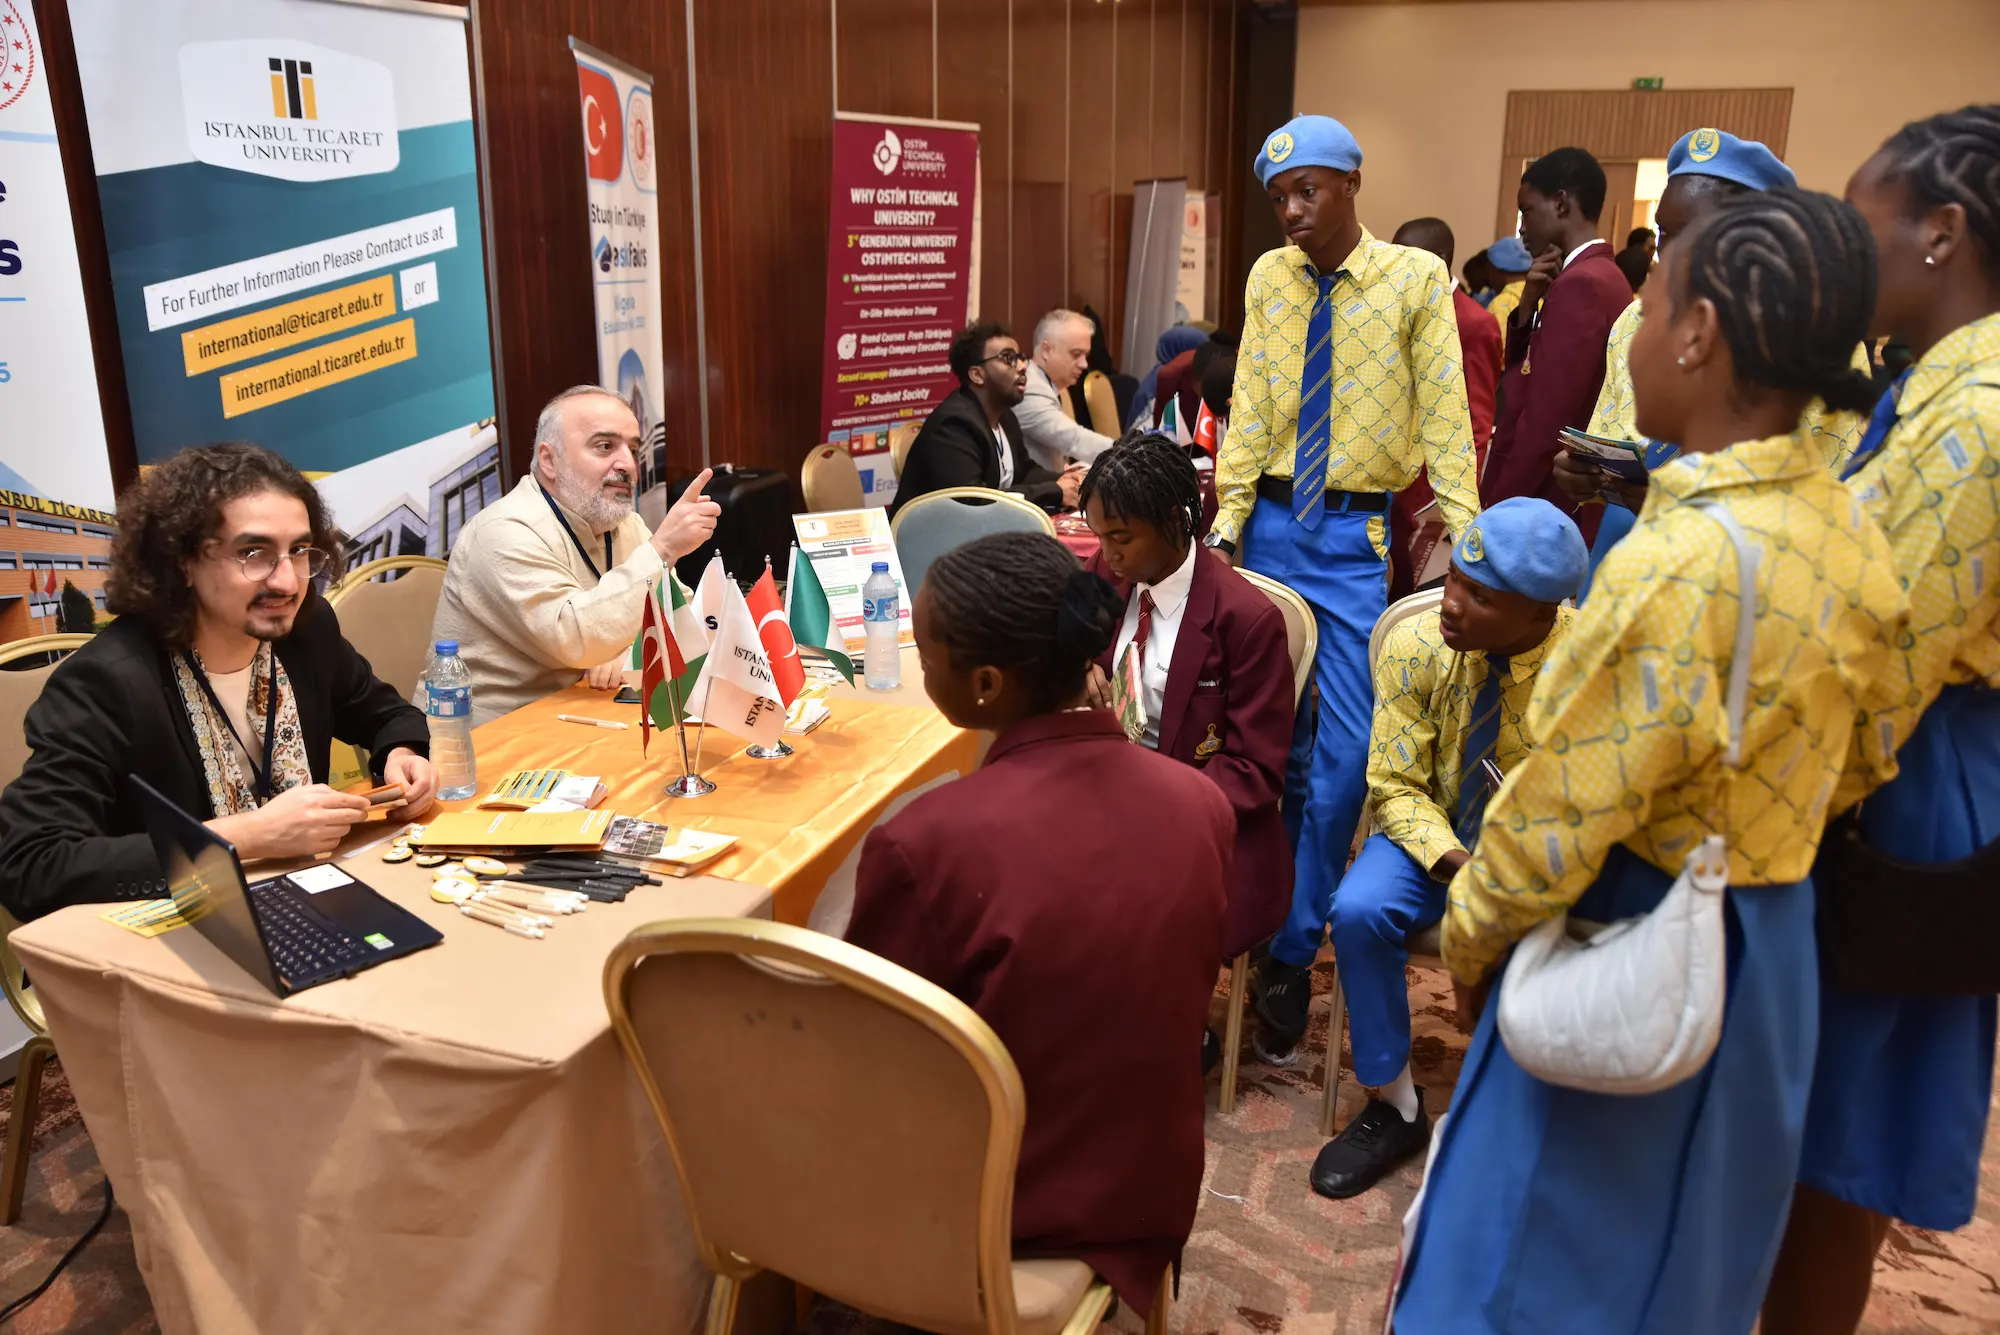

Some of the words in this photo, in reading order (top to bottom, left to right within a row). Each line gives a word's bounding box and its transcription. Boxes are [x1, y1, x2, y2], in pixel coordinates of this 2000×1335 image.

[205, 121, 298, 142] ISTANBUL
[303, 127, 384, 147] TICARET
[242, 144, 355, 164] UNIVERSITY
[904, 149, 945, 162] TECHNICAL
[902, 161, 947, 172] UNIVERSITY
[850, 187, 876, 204] WHY
[908, 190, 959, 206] TECHNICAL
[591, 203, 613, 230] Study
[614, 205, 623, 226] in
[874, 210, 936, 226] UNIVERSITY?
[859, 234, 911, 249] GENERATION
[912, 234, 958, 248] UNIVERSITY
[918, 251, 946, 265] MODEL
[161, 294, 186, 316] For
[189, 280, 240, 308] Further
[243, 259, 321, 292] Information
[323, 246, 364, 272] Please
[366, 232, 413, 259] Contact
[415, 231, 430, 246] us
[432, 225, 445, 242] at
[414, 279, 427, 296] or
[198, 291, 385, 360] international@ticaret.edu.tr
[236, 336, 406, 402] international.ticaret.edu.tr
[870, 390, 902, 405] Student
[902, 387, 931, 402] Society
